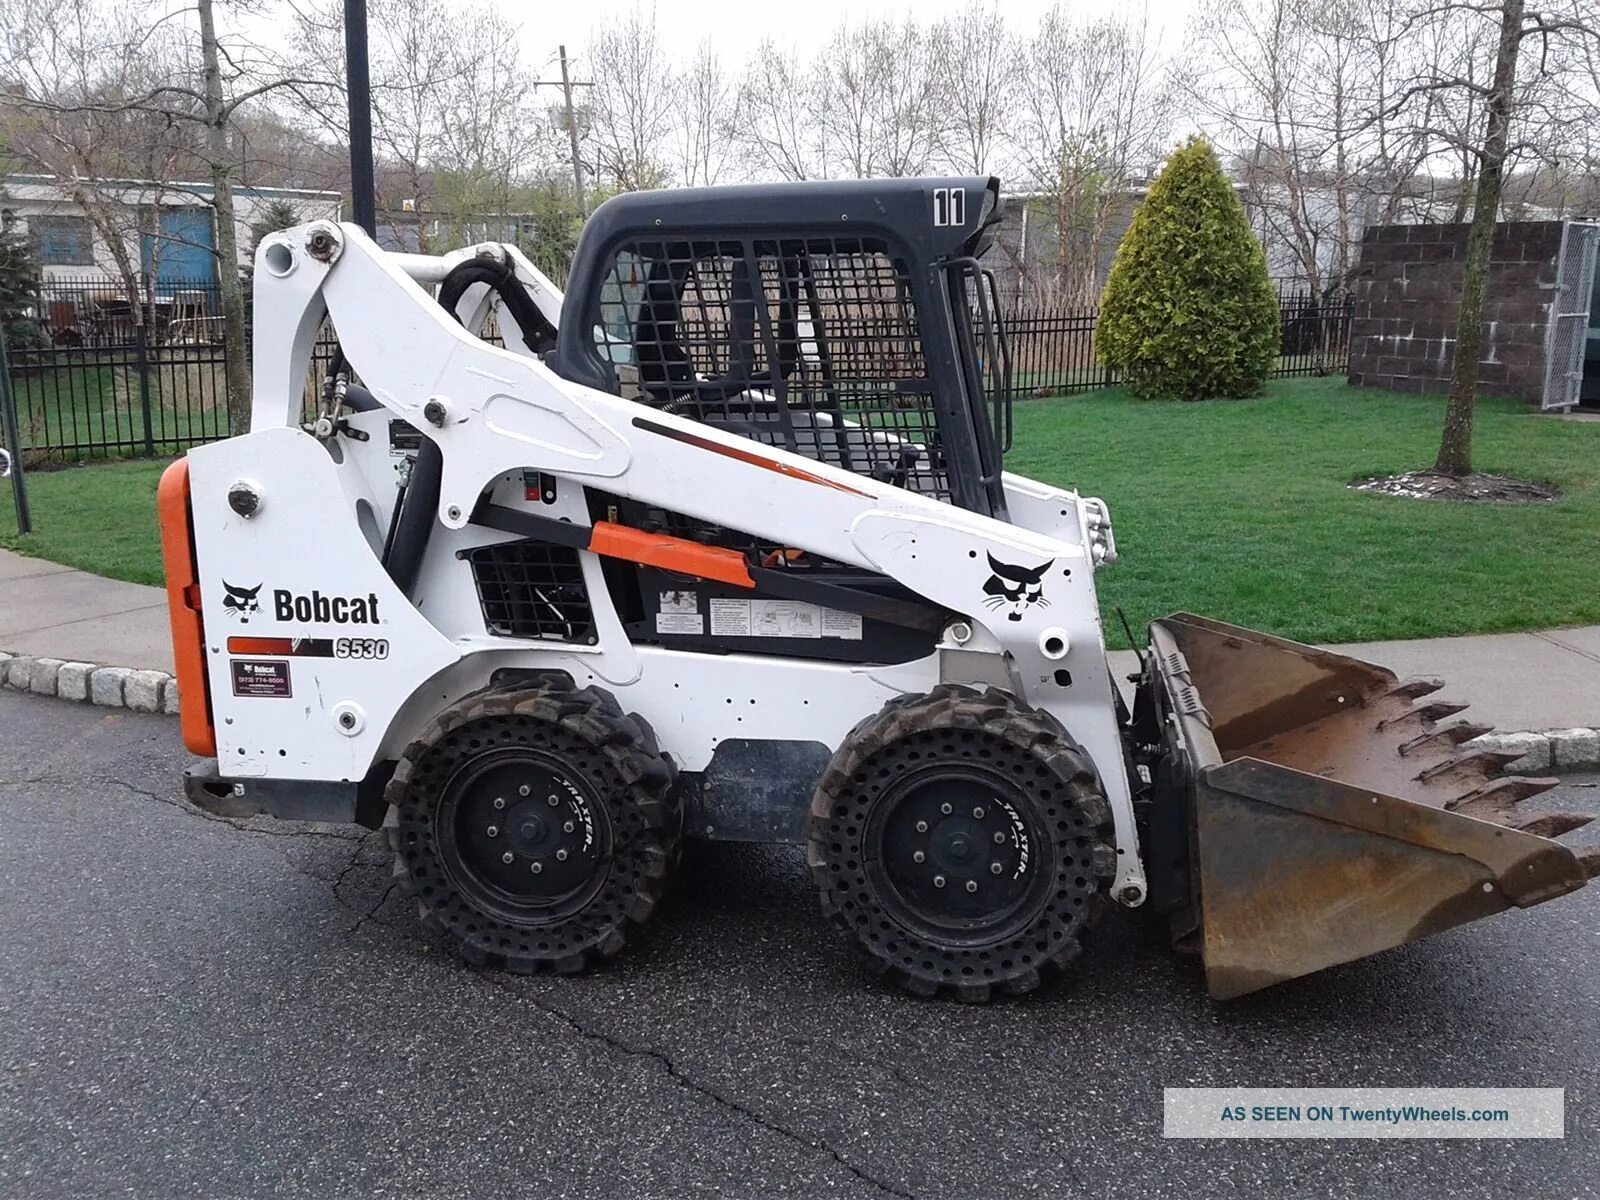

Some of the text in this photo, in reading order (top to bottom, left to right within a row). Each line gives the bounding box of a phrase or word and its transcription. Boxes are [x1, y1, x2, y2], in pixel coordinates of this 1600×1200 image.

[934, 188, 965, 227] 11
[273, 589, 380, 624] Bobcat
[336, 637, 389, 660] S530
[562, 780, 593, 845] TRAXTER
[1003, 802, 1029, 874] TRAXTER
